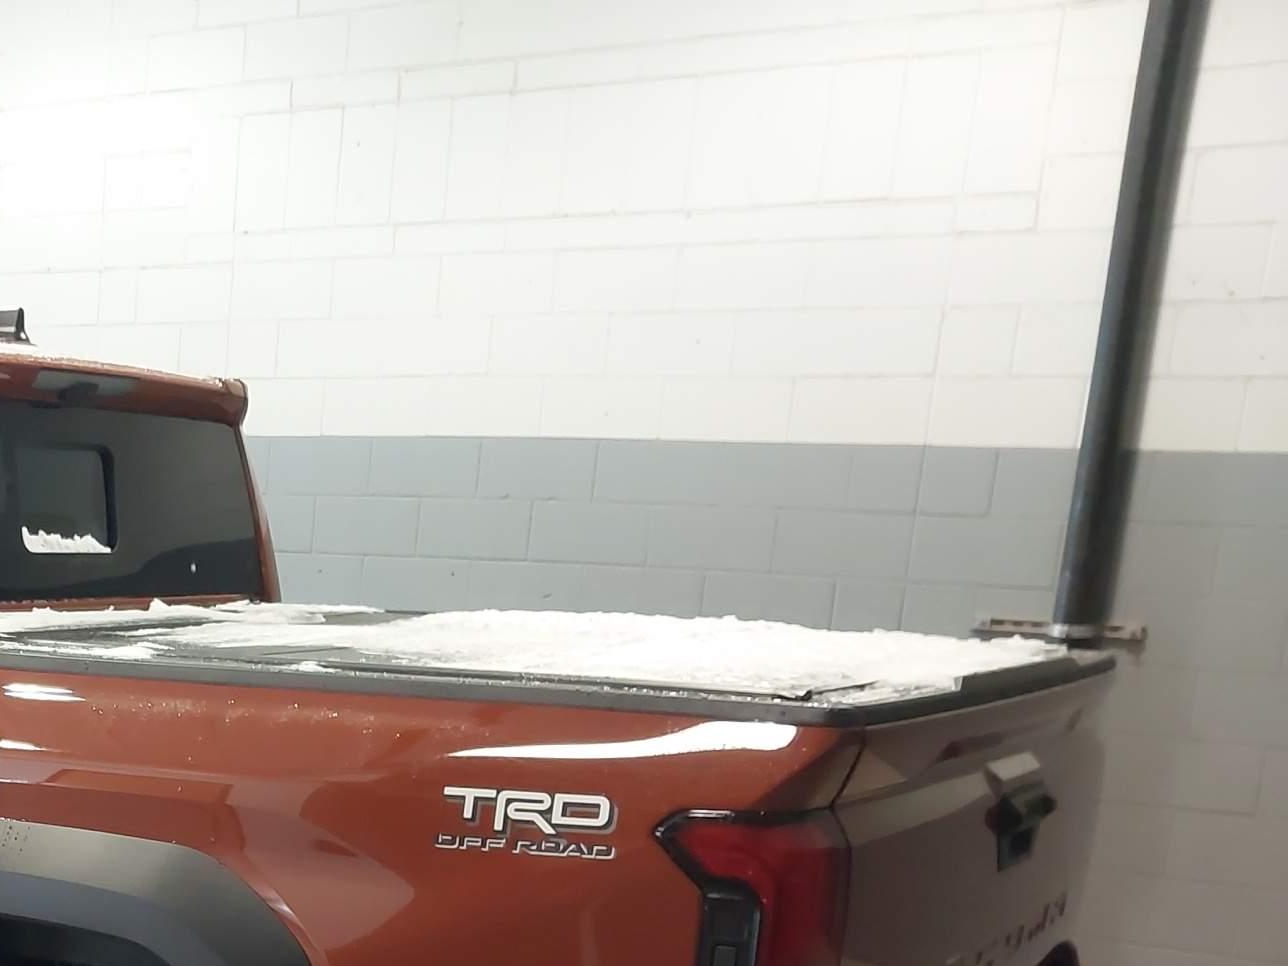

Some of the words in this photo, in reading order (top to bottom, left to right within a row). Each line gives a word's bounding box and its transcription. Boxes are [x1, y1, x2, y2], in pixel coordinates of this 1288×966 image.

[443, 785, 613, 835] TRD
[434, 832, 507, 852] OFF
[512, 838, 616, 860] ROAD
